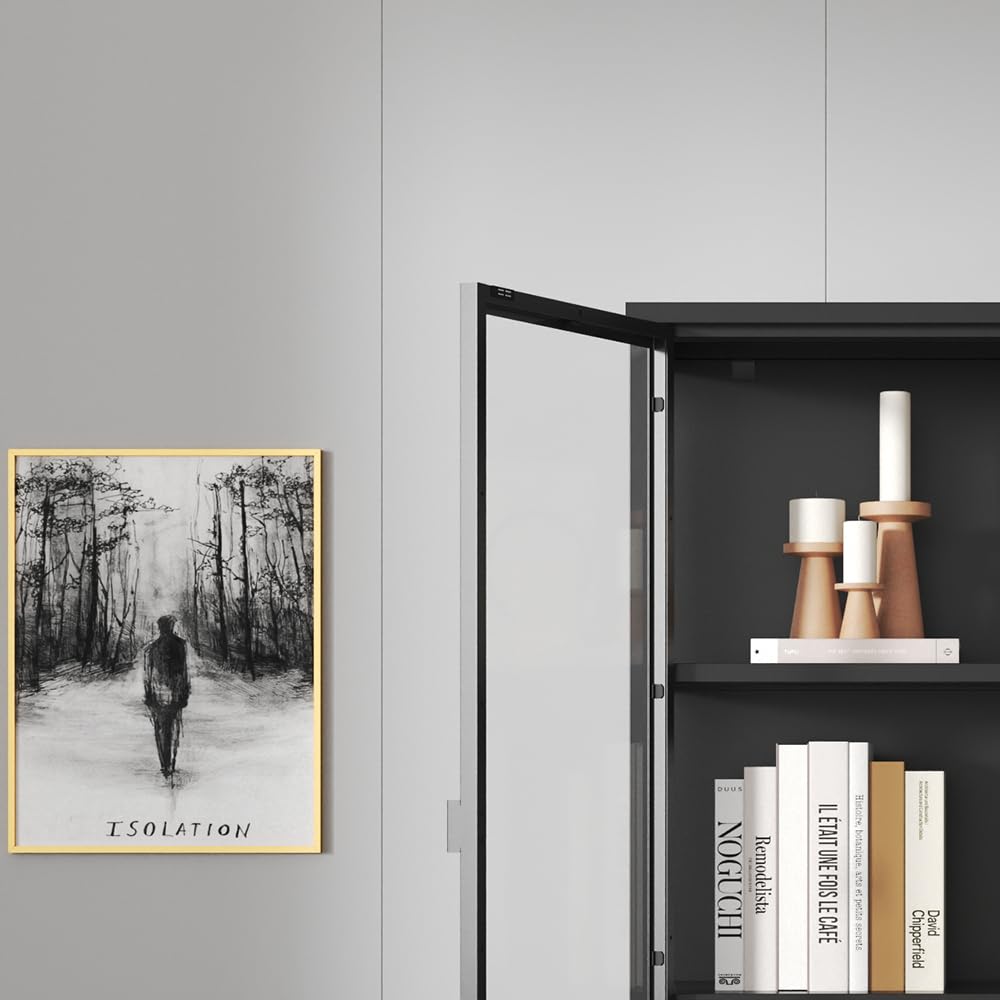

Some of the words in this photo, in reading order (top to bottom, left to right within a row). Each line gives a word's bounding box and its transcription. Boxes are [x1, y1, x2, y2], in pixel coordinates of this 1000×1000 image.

[819, 804, 837, 813] IL
[855, 794, 863, 827] Histoire,
[106, 820, 250, 838] ISOLATION
[819, 817, 841, 847] ÉTAIT
[819, 850, 837, 871] UNE
[854, 830, 863, 869] botanique,
[717, 821, 742, 938] NOGUCHI
[755, 836, 771, 914] Remodelista
[819, 875, 837, 897] FOIS
[855, 871, 863, 887] arts
[819, 901, 837, 913] LE
[854, 899, 863, 921] petits
[819, 917, 841, 944] CAFÉ
[927, 910, 940, 936] David
[855, 923, 863, 951] secrets
[909, 910, 925, 969] Chipperfield
